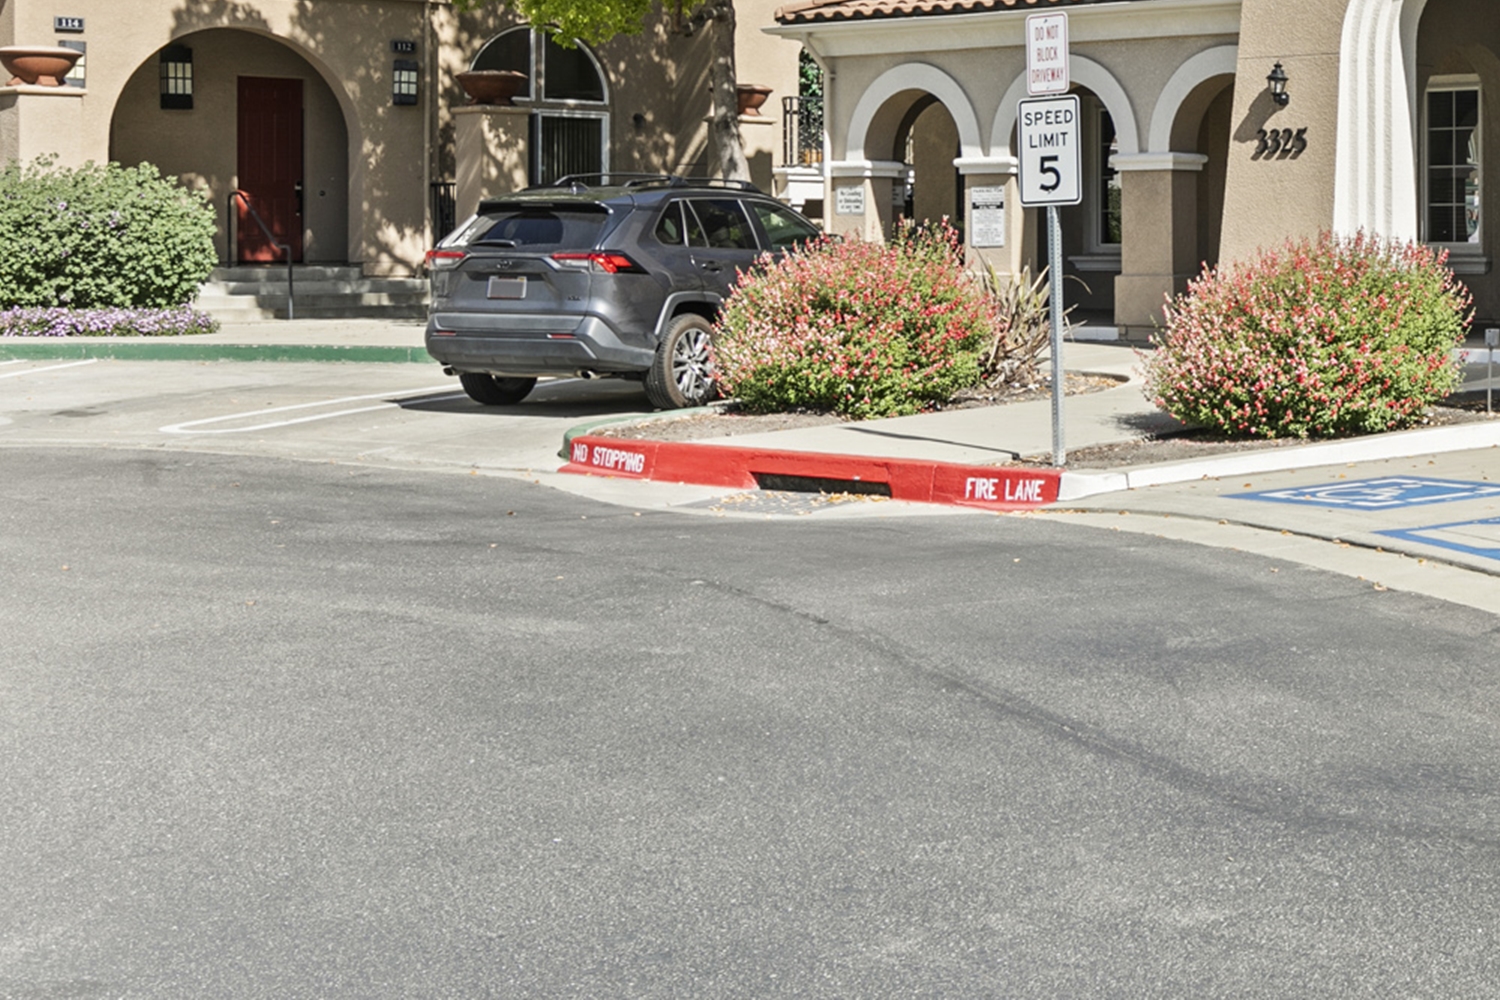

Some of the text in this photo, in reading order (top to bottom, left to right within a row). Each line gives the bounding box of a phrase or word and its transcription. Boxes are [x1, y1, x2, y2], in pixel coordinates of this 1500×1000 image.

[62, 18, 79, 28] 114
[1035, 24, 1058, 41] DO NOT
[1037, 46, 1058, 62] BLOCK
[1032, 67, 1064, 84] DRIVEWAY
[1024, 109, 1073, 126] SPEED
[1029, 132, 1068, 148] LIMIT
[1256, 126, 1308, 156] 3325
[1039, 155, 1061, 193] 5
[573, 443, 645, 473] NO STOPPING
[965, 477, 1045, 501] FIRE LANE
